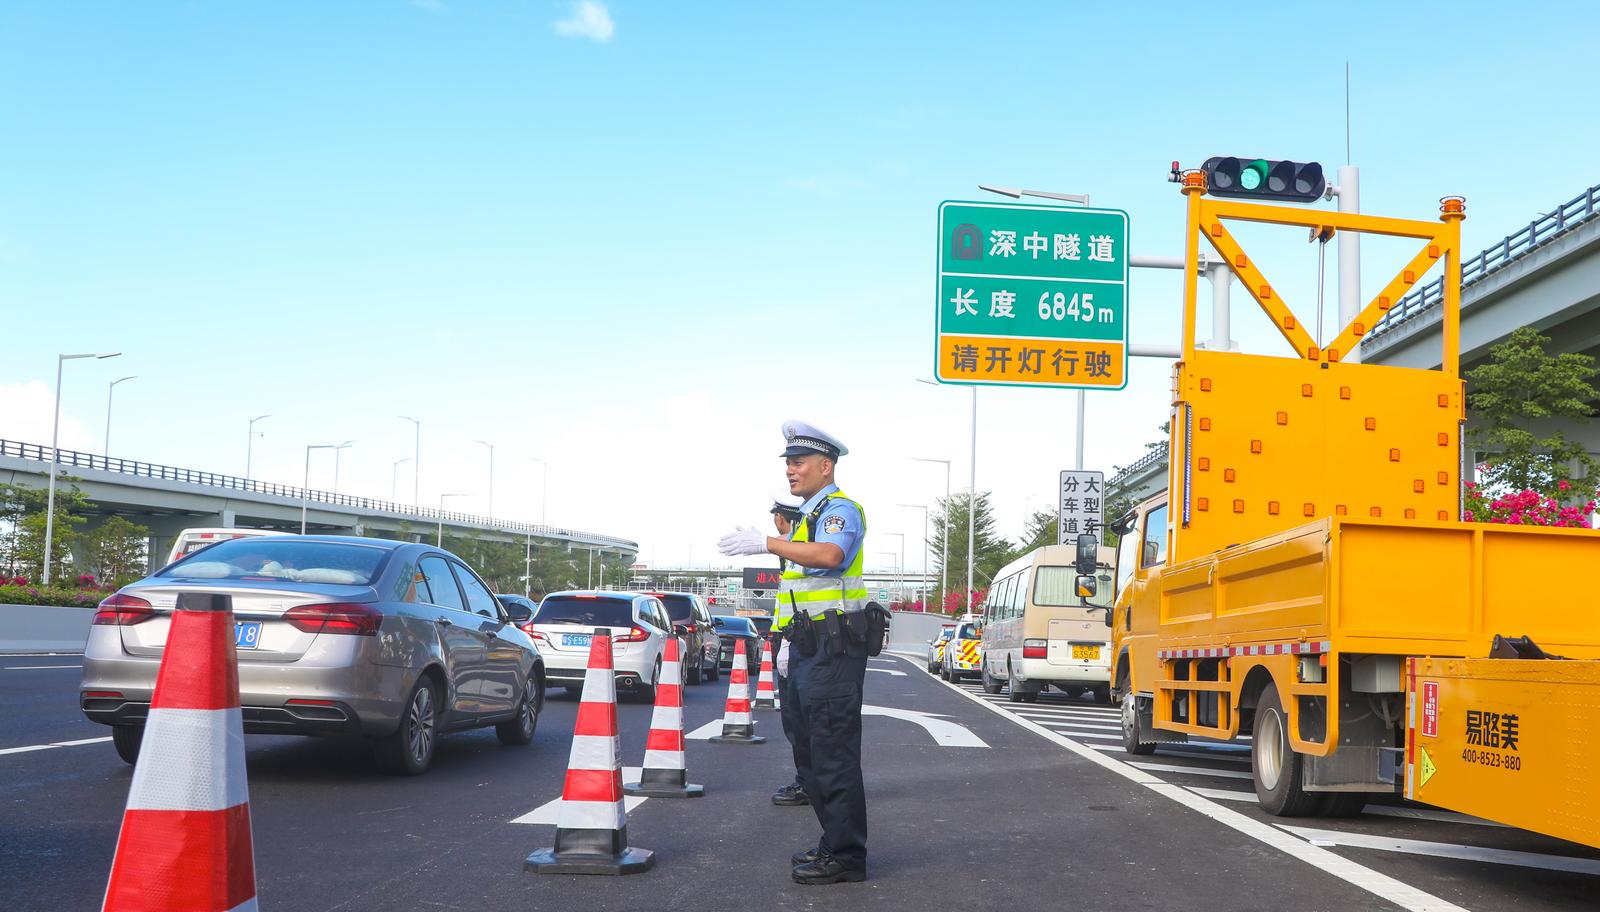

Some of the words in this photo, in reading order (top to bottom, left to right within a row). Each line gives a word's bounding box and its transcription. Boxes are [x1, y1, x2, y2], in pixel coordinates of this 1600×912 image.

[988, 229, 1116, 263] 深中隧道
[950, 288, 1017, 319] 长度
[1038, 291, 1114, 324] 6845m
[951, 344, 1112, 378] 请开灯行驶
[1083, 476, 1100, 544] 大型车
[1465, 710, 1519, 751] 易路美
[1462, 748, 1521, 771] 400-8523-880
